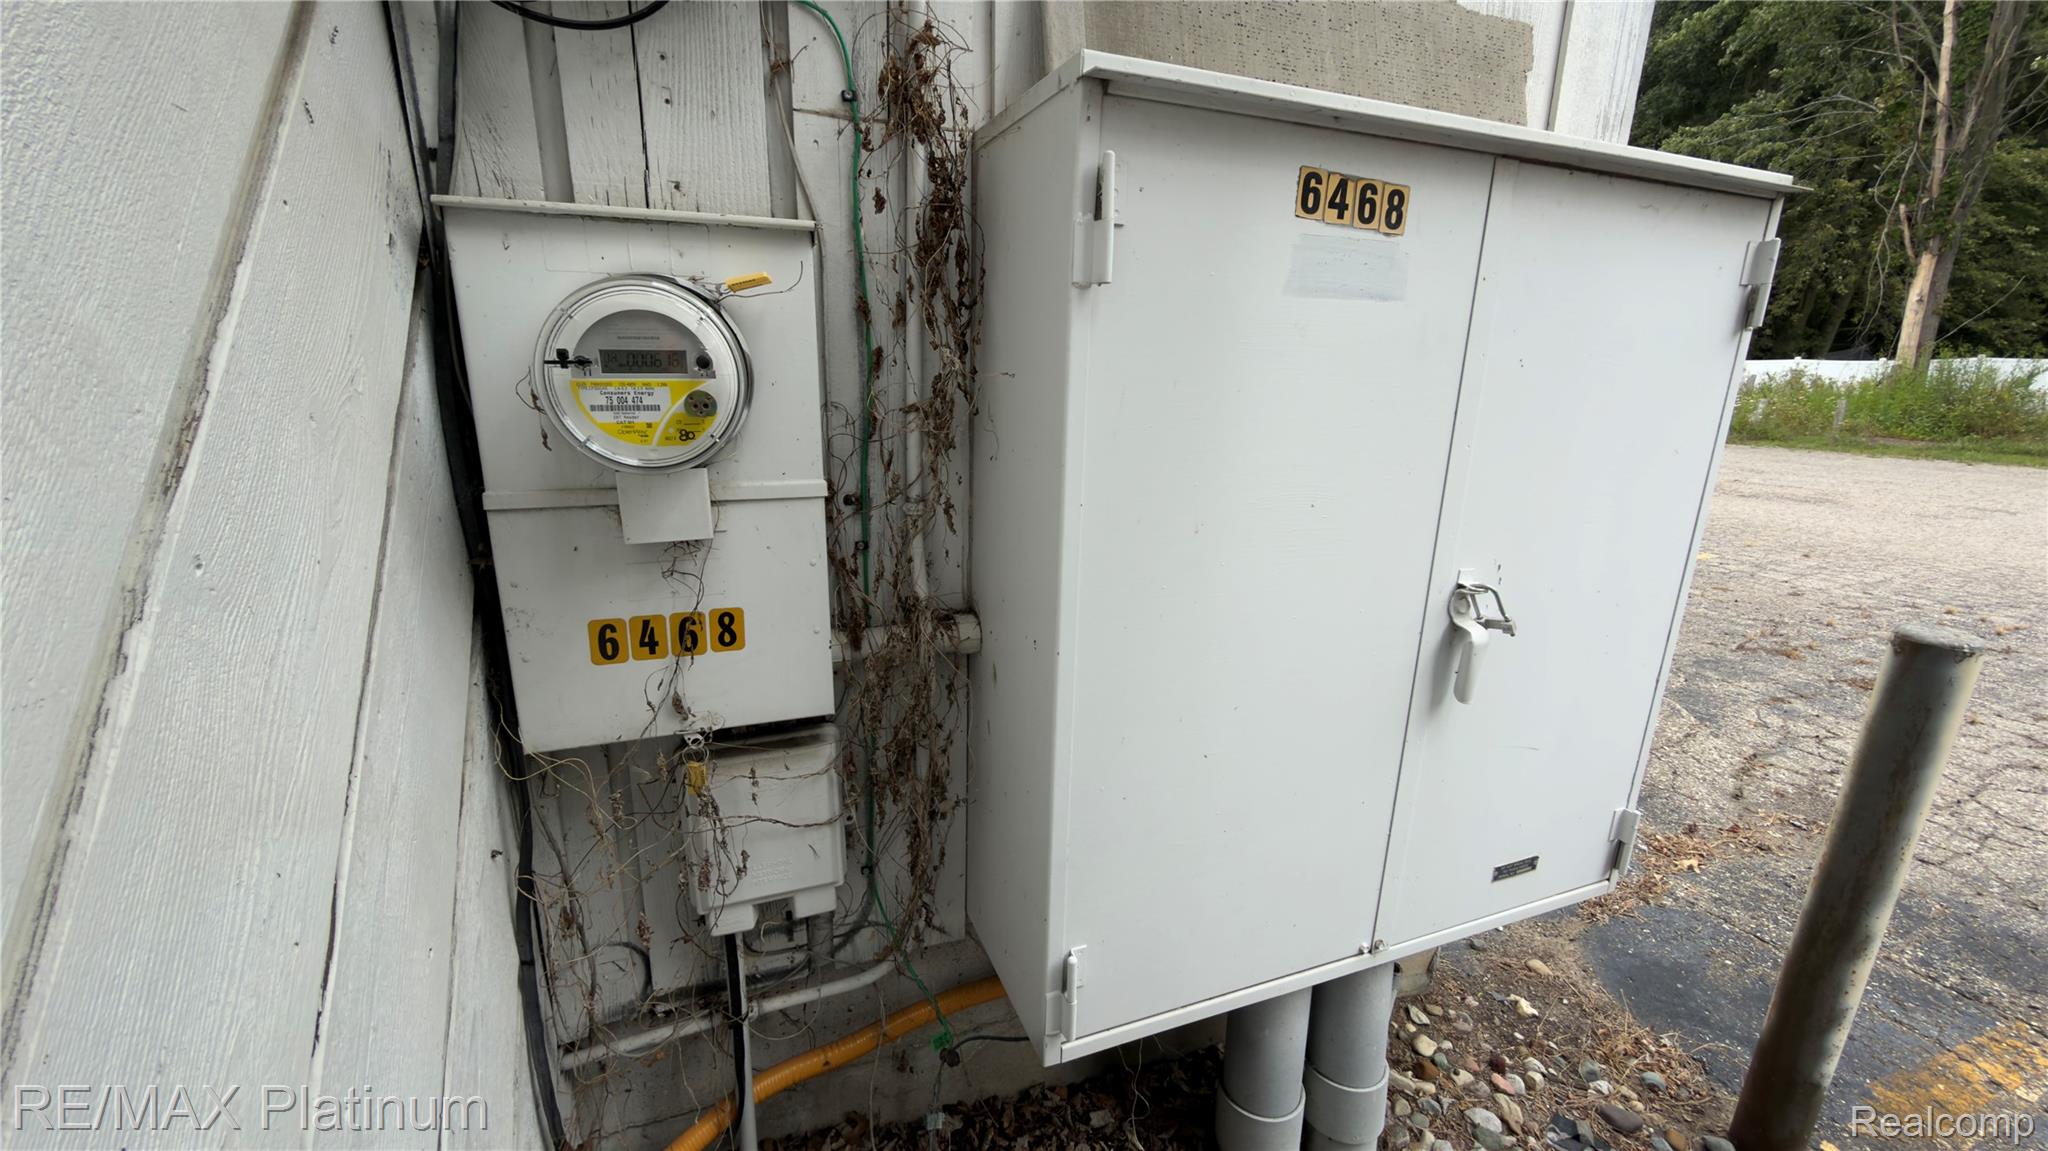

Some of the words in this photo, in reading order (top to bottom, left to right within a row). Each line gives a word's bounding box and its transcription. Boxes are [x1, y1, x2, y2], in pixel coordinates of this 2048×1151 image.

[1300, 171, 1405, 230] 6468
[605, 396, 614, 404] 75
[616, 396, 629, 405] 004
[632, 396, 643, 405] 474
[597, 611, 738, 661] 6468
